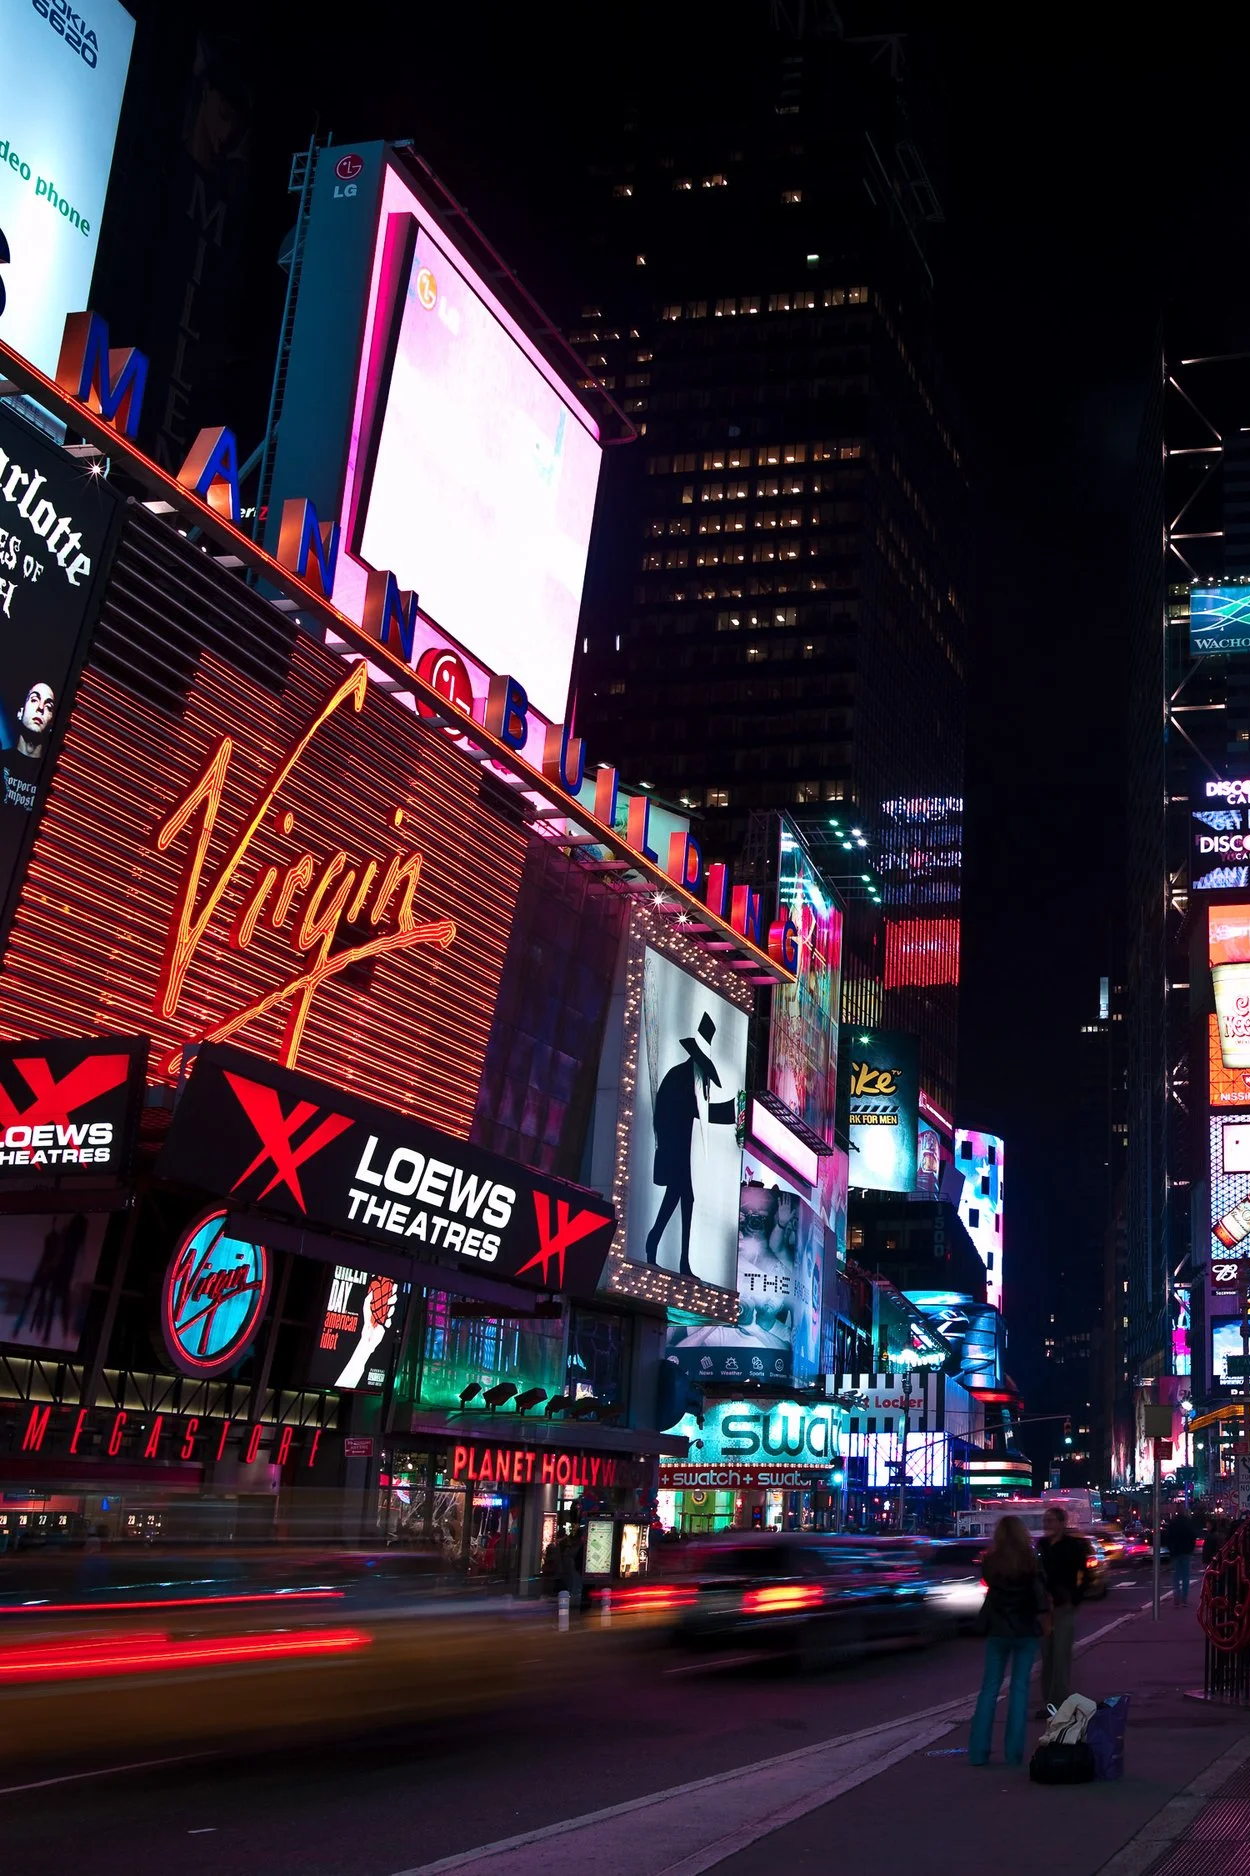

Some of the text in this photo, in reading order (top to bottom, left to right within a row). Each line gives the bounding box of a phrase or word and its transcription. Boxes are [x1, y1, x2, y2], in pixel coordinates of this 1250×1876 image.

[35, 176, 91, 237] phone
[333, 183, 358, 199] LG
[23, 554, 44, 584] OF
[0, 228, 798, 973] MANN BUILDING
[156, 659, 457, 1073] Virgin
[0, 1122, 113, 1147] OEWS
[862, 1114, 879, 1125] FOR
[879, 1115, 898, 1125] MEN
[353, 1135, 517, 1229] LOEWS
[346, 1187, 502, 1264] THEATRES
[173, 1230, 262, 1356] Virgin
[327, 1278, 354, 1314] DAY
[744, 1272, 791, 1295] THE
[324, 1311, 360, 1333] american
[319, 1328, 339, 1351] idiot
[874, 1395, 924, 1409] Locker
[21, 1405, 323, 1468] MEGASTORE
[453, 1446, 536, 1483] PLANET
[673, 1469, 813, 1486] swatch swat
